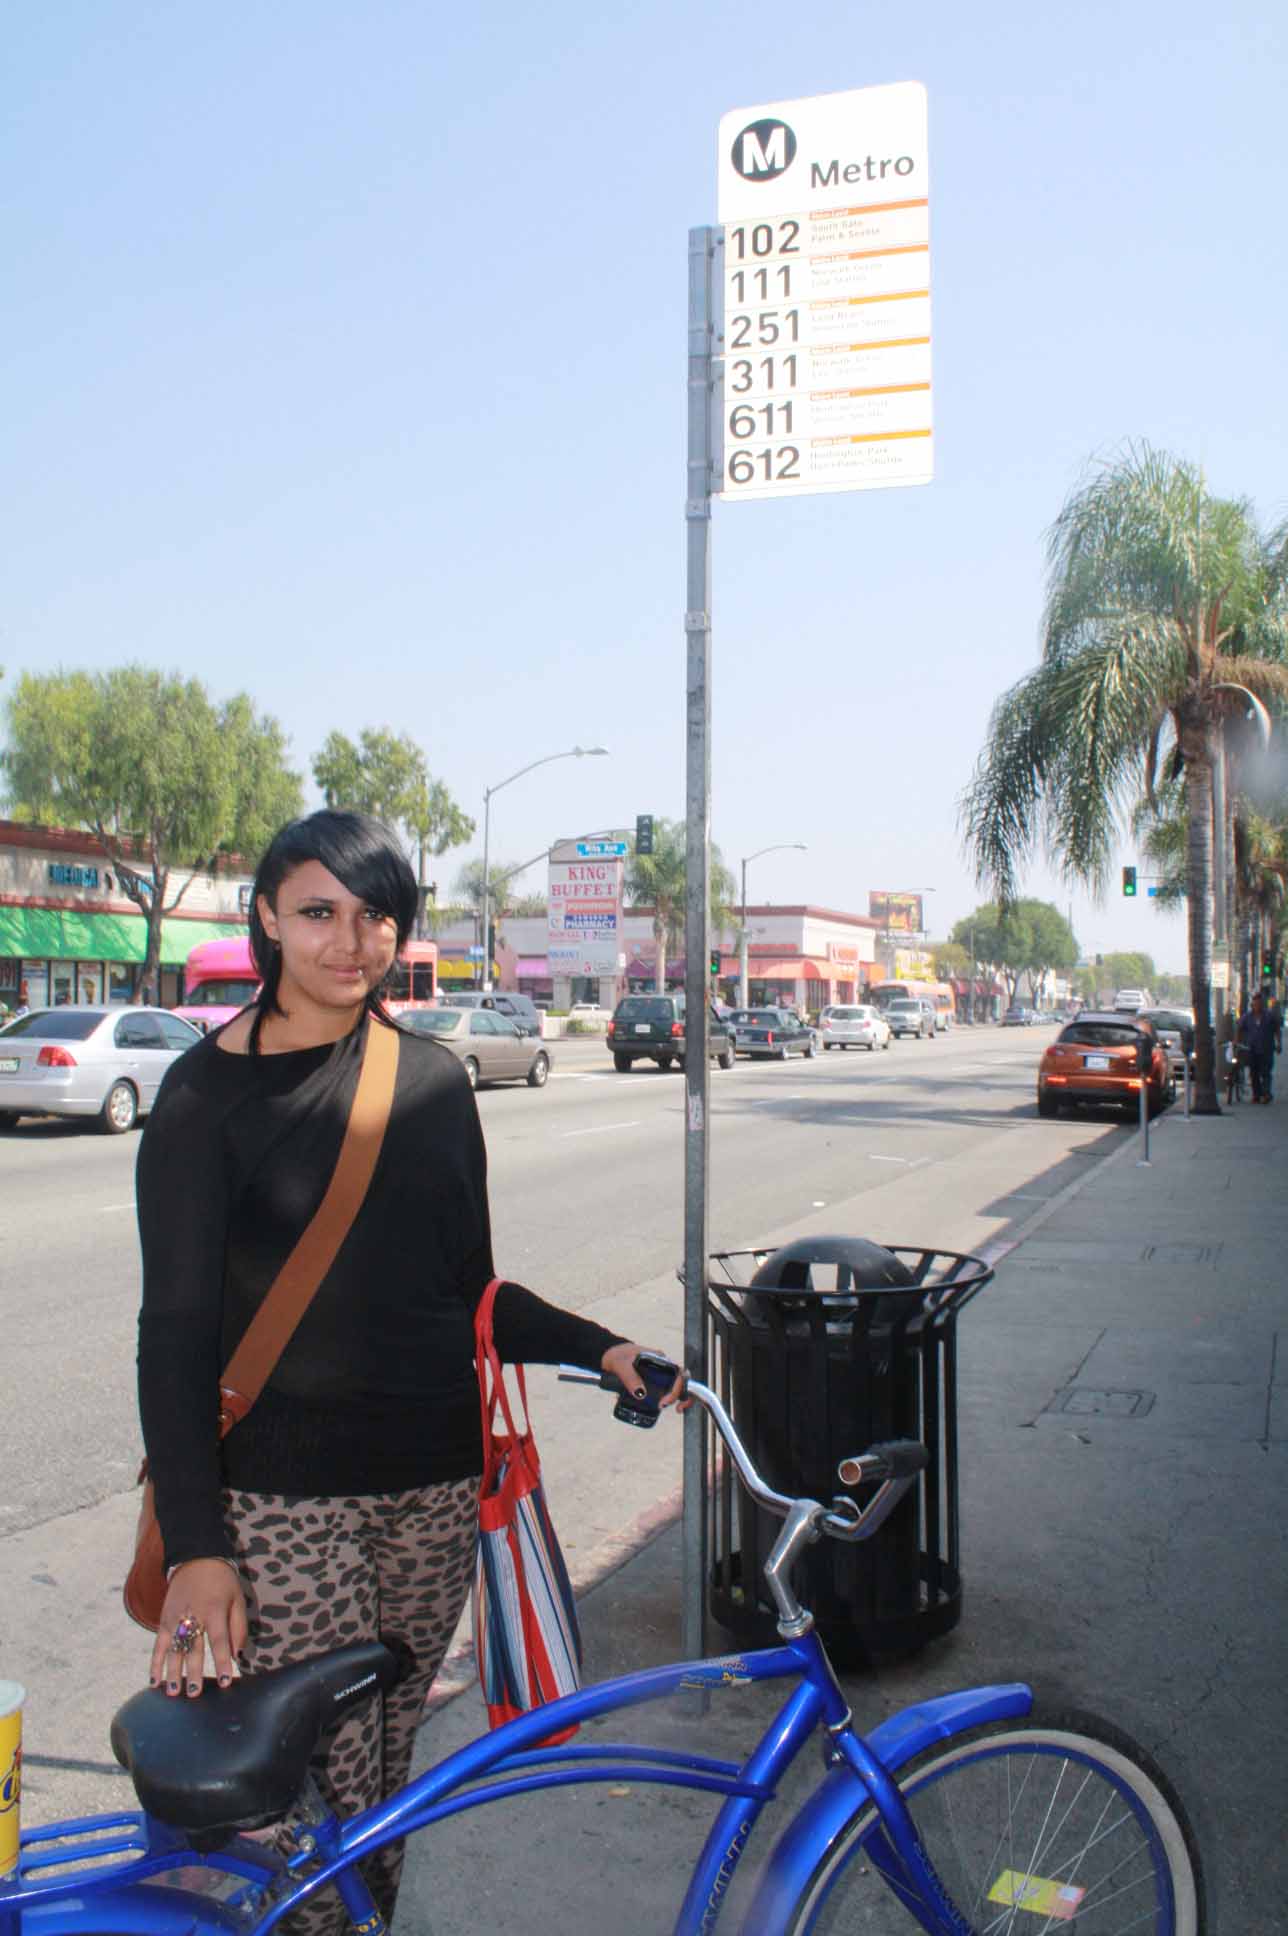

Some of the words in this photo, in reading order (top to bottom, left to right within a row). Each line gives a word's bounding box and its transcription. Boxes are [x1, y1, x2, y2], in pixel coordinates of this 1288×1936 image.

[743, 127, 786, 174] M
[810, 155, 915, 189] Metro
[731, 220, 801, 259] 102
[731, 264, 791, 303] 111
[730, 309, 800, 349] 251
[731, 354, 797, 393] 311
[729, 400, 793, 440] 611
[728, 446, 801, 484] 612
[551, 884, 616, 897] BUFFET
[568, 866, 606, 881] KING
[566, 920, 615, 929] PHARMACY
